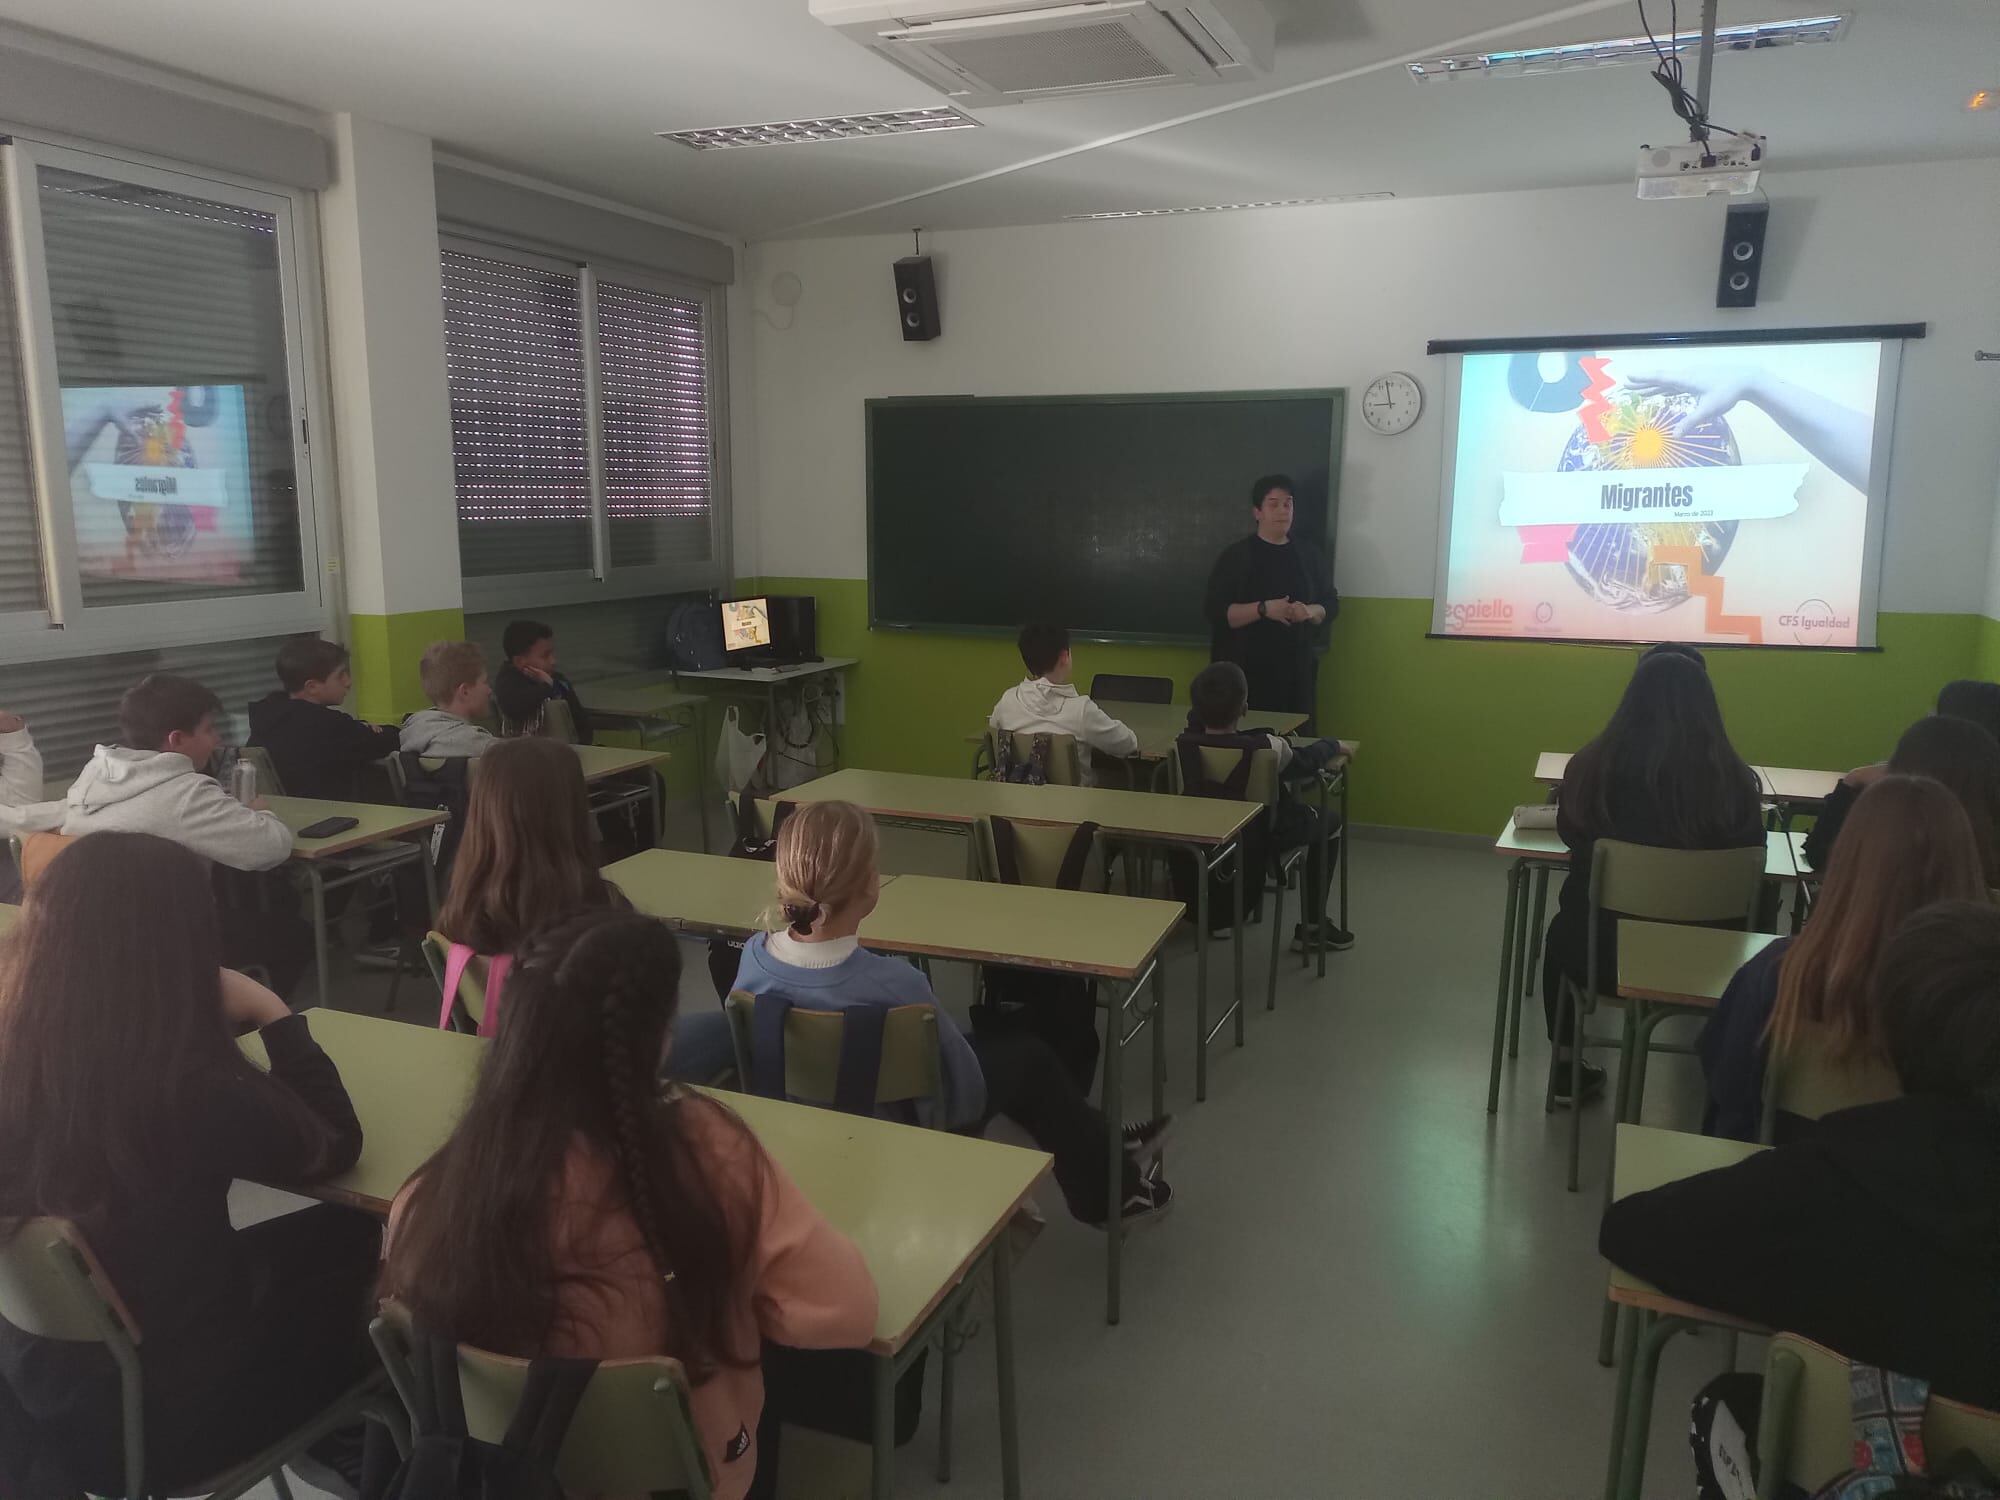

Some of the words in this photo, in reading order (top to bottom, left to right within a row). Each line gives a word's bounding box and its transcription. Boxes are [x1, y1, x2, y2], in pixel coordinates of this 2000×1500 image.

[1601, 482, 1693, 512] Migrantes
[1779, 615, 1799, 627] CFS
[1801, 616, 1850, 630] Igualdad
